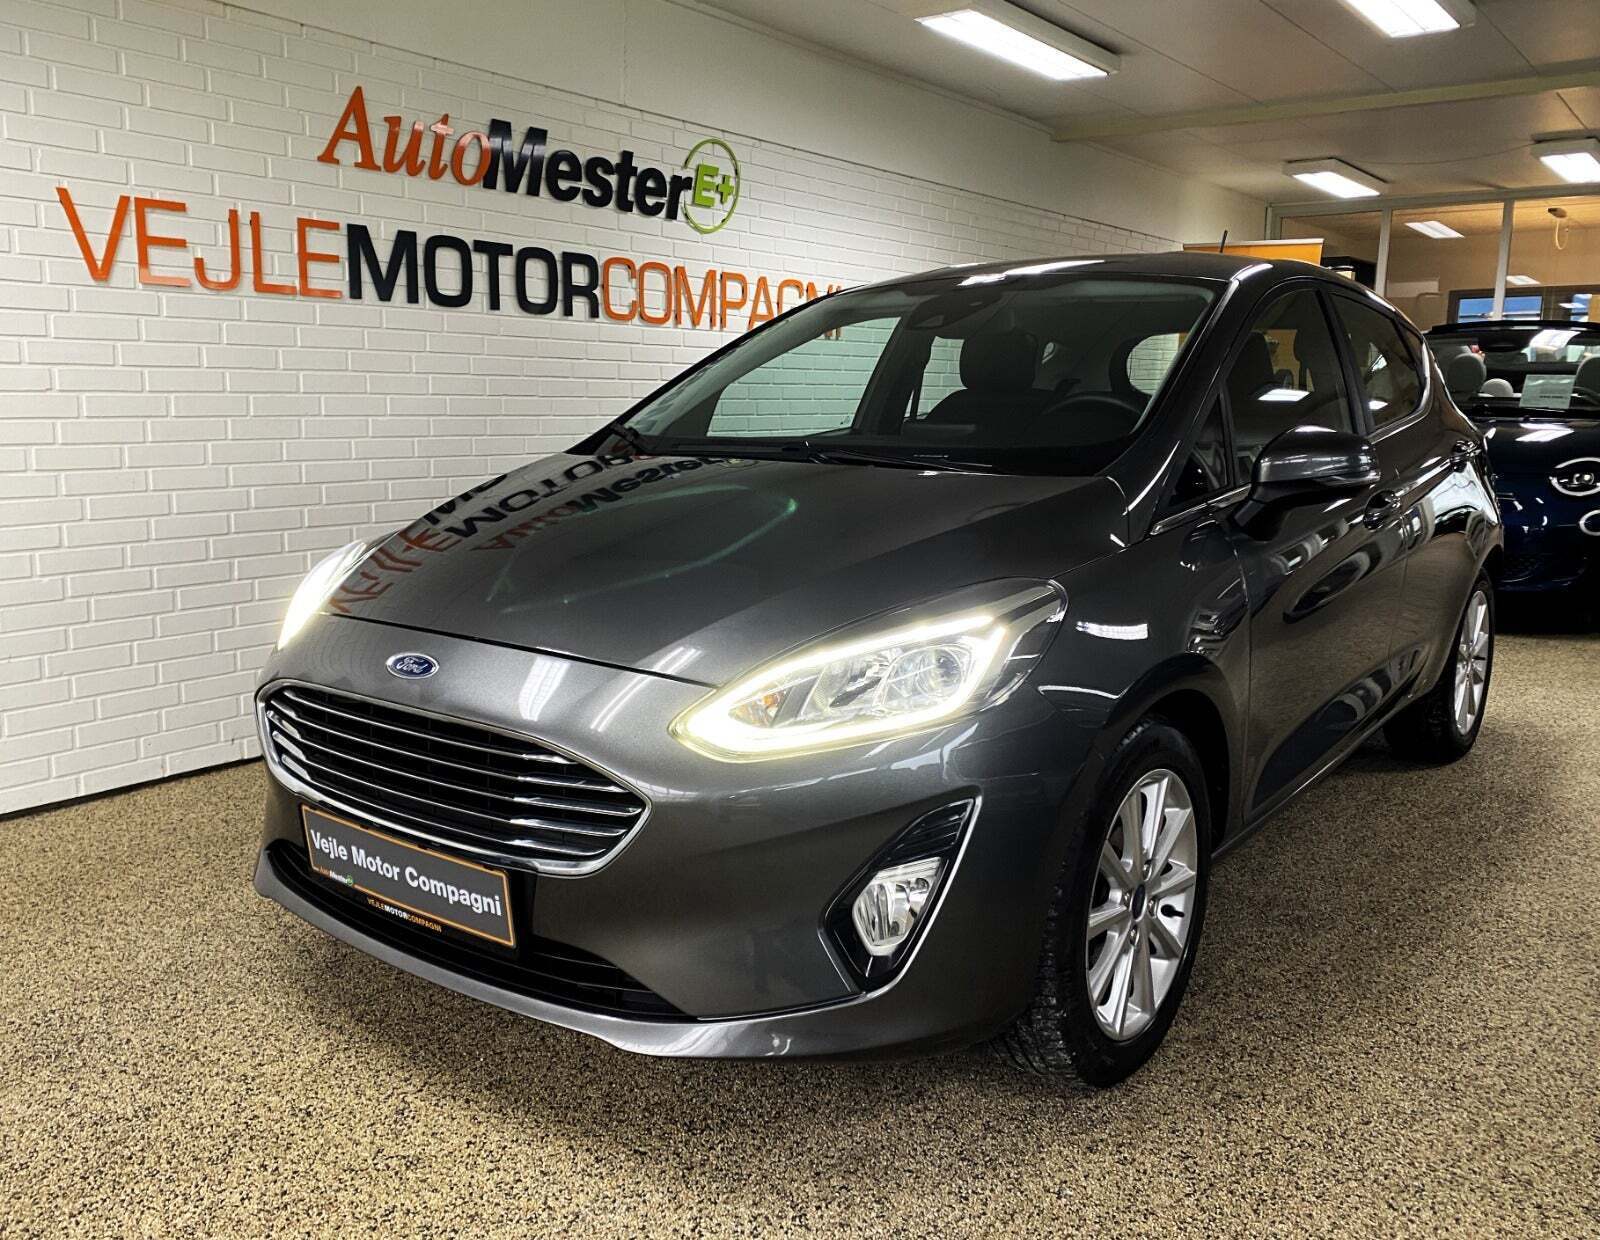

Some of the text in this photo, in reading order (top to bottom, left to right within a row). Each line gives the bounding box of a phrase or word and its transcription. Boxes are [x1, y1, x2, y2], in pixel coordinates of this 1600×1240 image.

[317, 86, 692, 221] AutoMester
[310, 829, 502, 916] Vejle Motor Compagni
